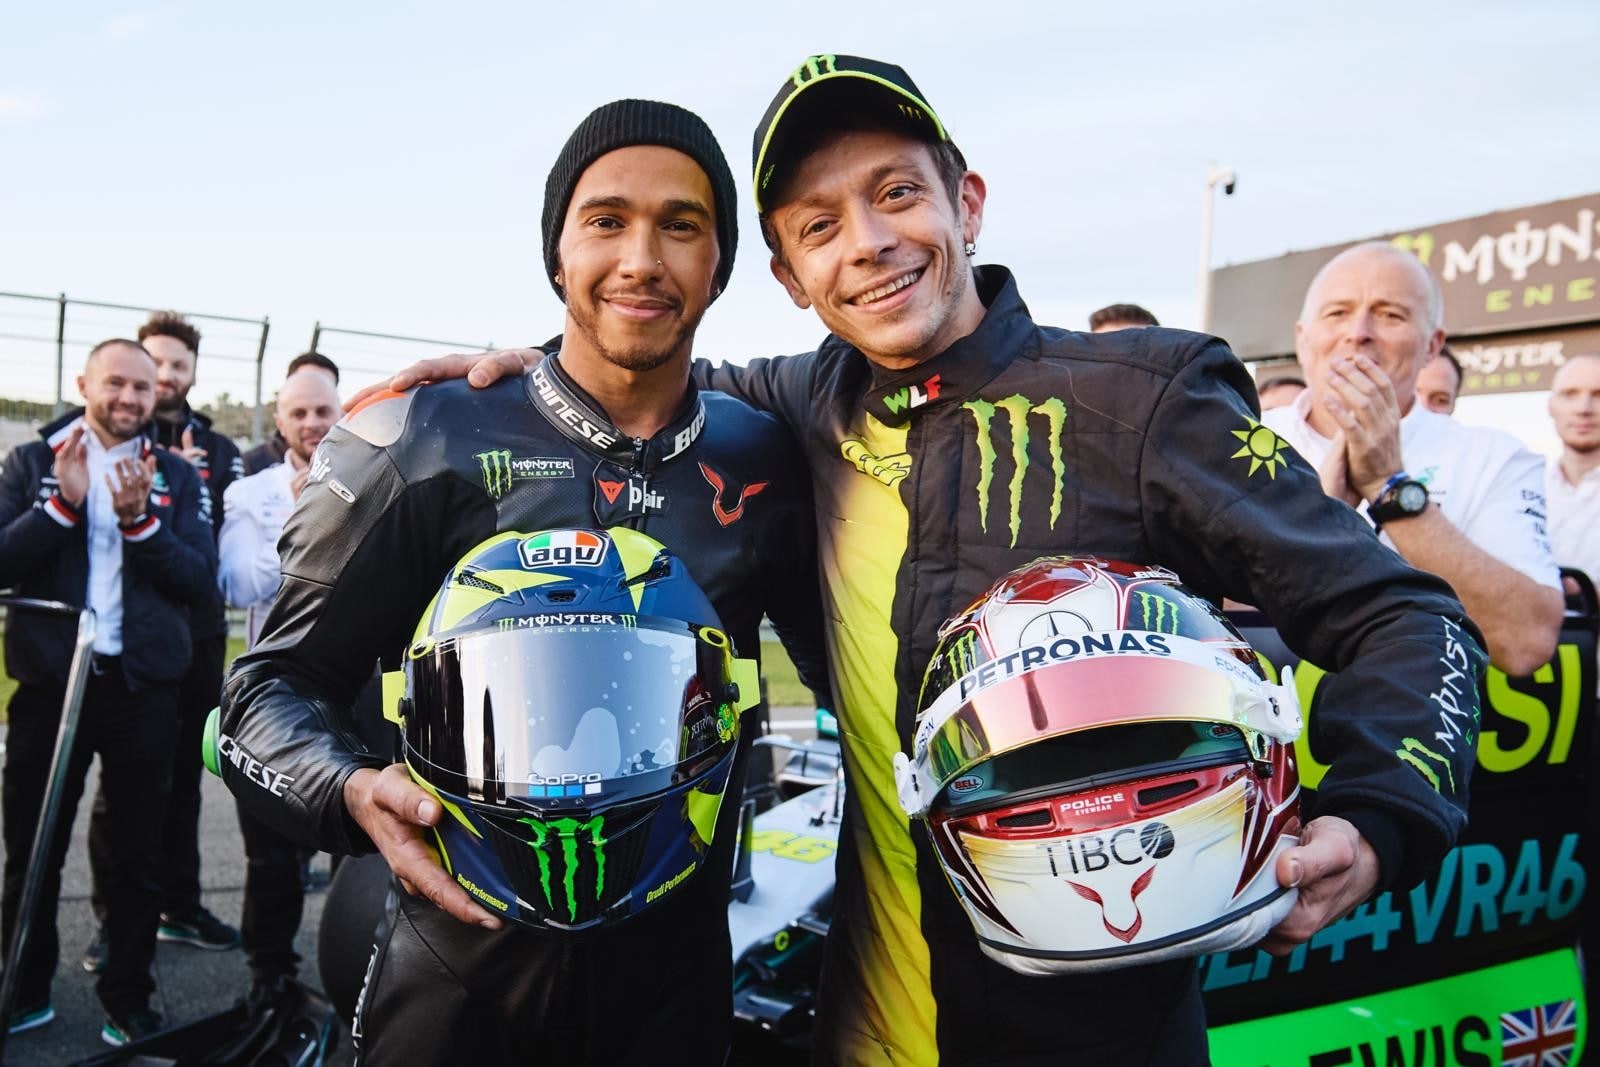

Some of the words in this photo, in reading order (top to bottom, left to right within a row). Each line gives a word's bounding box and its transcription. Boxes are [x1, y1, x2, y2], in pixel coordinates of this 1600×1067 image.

[1442, 209, 1600, 285] MON
[531, 367, 616, 449] DAINESE
[512, 459, 572, 470] MONSTER
[531, 547, 596, 564] agv
[518, 613, 616, 628] MONSTER
[960, 633, 1172, 703] PETRONAS
[528, 773, 601, 785] GoPro
[955, 779, 979, 788] BELL
[1060, 792, 1125, 812] POLICE
[1075, 804, 1112, 816] EYEWEAR
[1036, 822, 1175, 877] TIBCO
